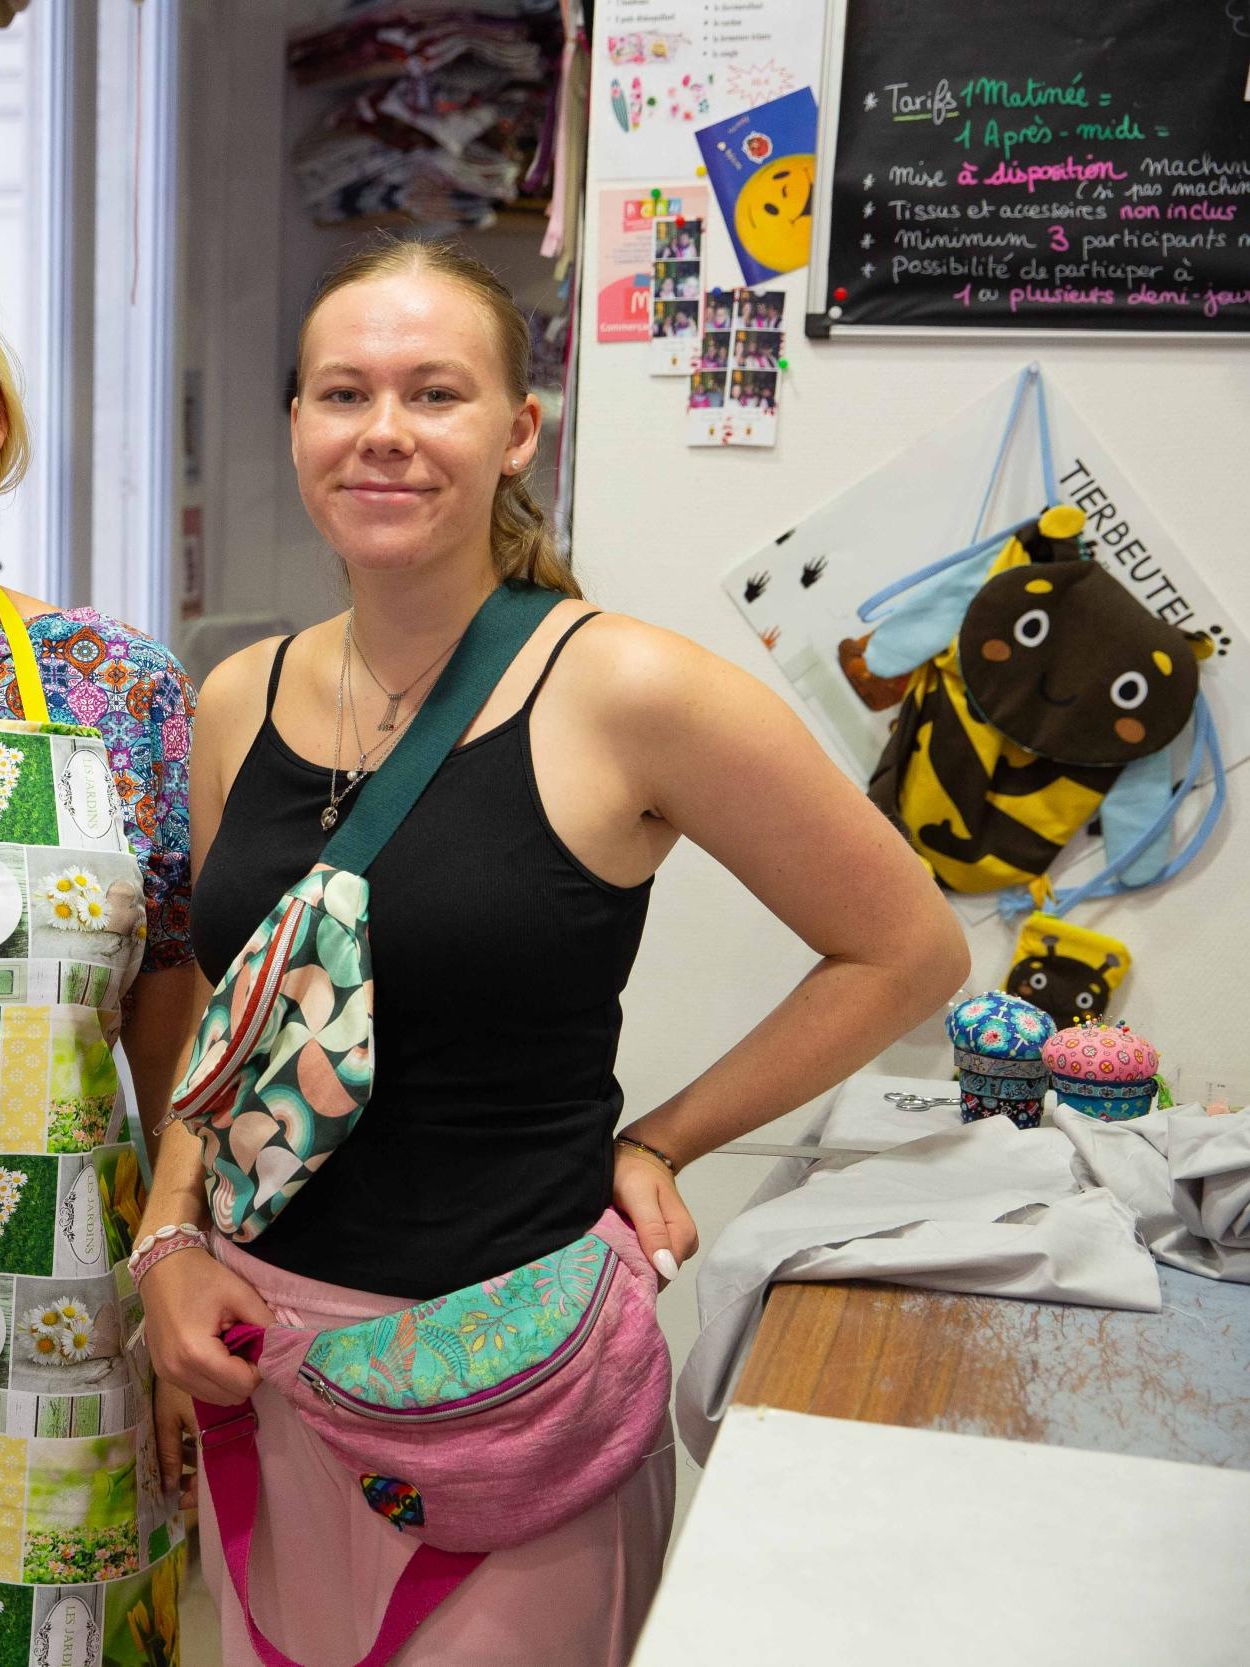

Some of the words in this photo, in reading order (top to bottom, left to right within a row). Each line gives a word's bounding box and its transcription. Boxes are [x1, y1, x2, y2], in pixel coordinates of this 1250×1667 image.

[884, 78, 957, 125] Tarifs
[975, 72, 1089, 108] Matinée
[954, 119, 972, 149] 1
[957, 161, 979, 186] à
[1125, 182, 1163, 203] pas
[887, 200, 962, 221] Tissus
[966, 198, 997, 220] et
[999, 201, 1108, 221] accessoires
[1119, 203, 1161, 221] non
[1166, 199, 1238, 221] inclus
[1047, 224, 1070, 252] 3
[1082, 226, 1228, 262] participants
[1019, 258, 1049, 281] de
[1054, 259, 1164, 290] participer
[1173, 256, 1195, 282] à
[953, 283, 972, 308] 1
[977, 288, 1000, 303] ou
[1008, 284, 1115, 313] plusieurs
[85, 778, 99, 829] JARDINS
[84, 1199, 95, 1254] JARDINS
[65, 1606, 76, 1625] LES
